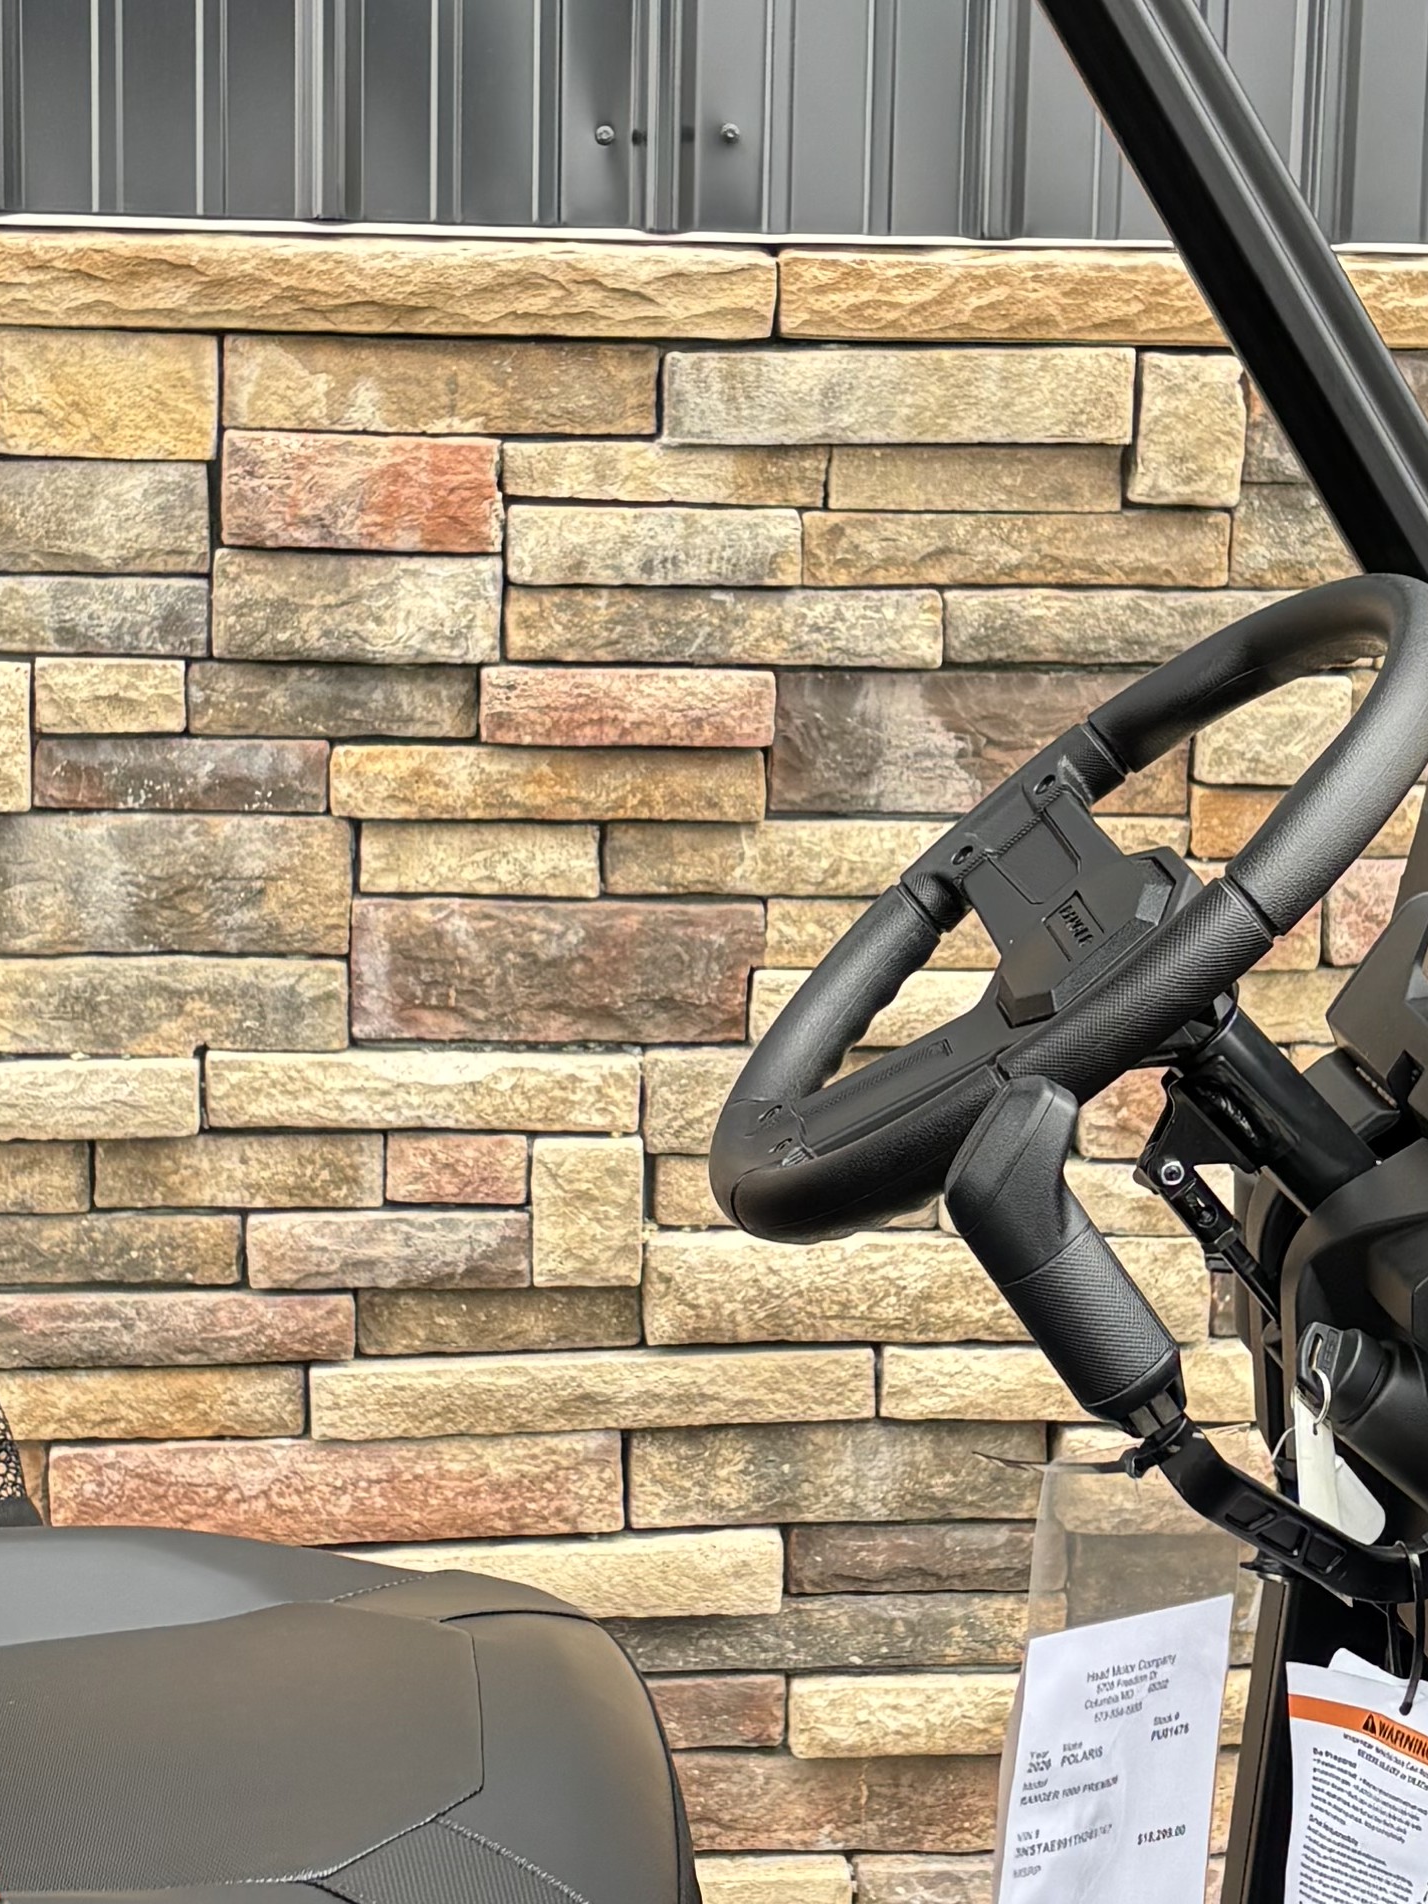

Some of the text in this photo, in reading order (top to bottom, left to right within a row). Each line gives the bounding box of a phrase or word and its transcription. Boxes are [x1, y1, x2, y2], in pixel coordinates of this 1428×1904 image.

[1138, 1654, 1177, 1673] Company
[1084, 1694, 1119, 1710] Columbia
[1060, 1746, 1104, 1767] POLARIS
[1020, 1789, 1060, 1806] RANGER
